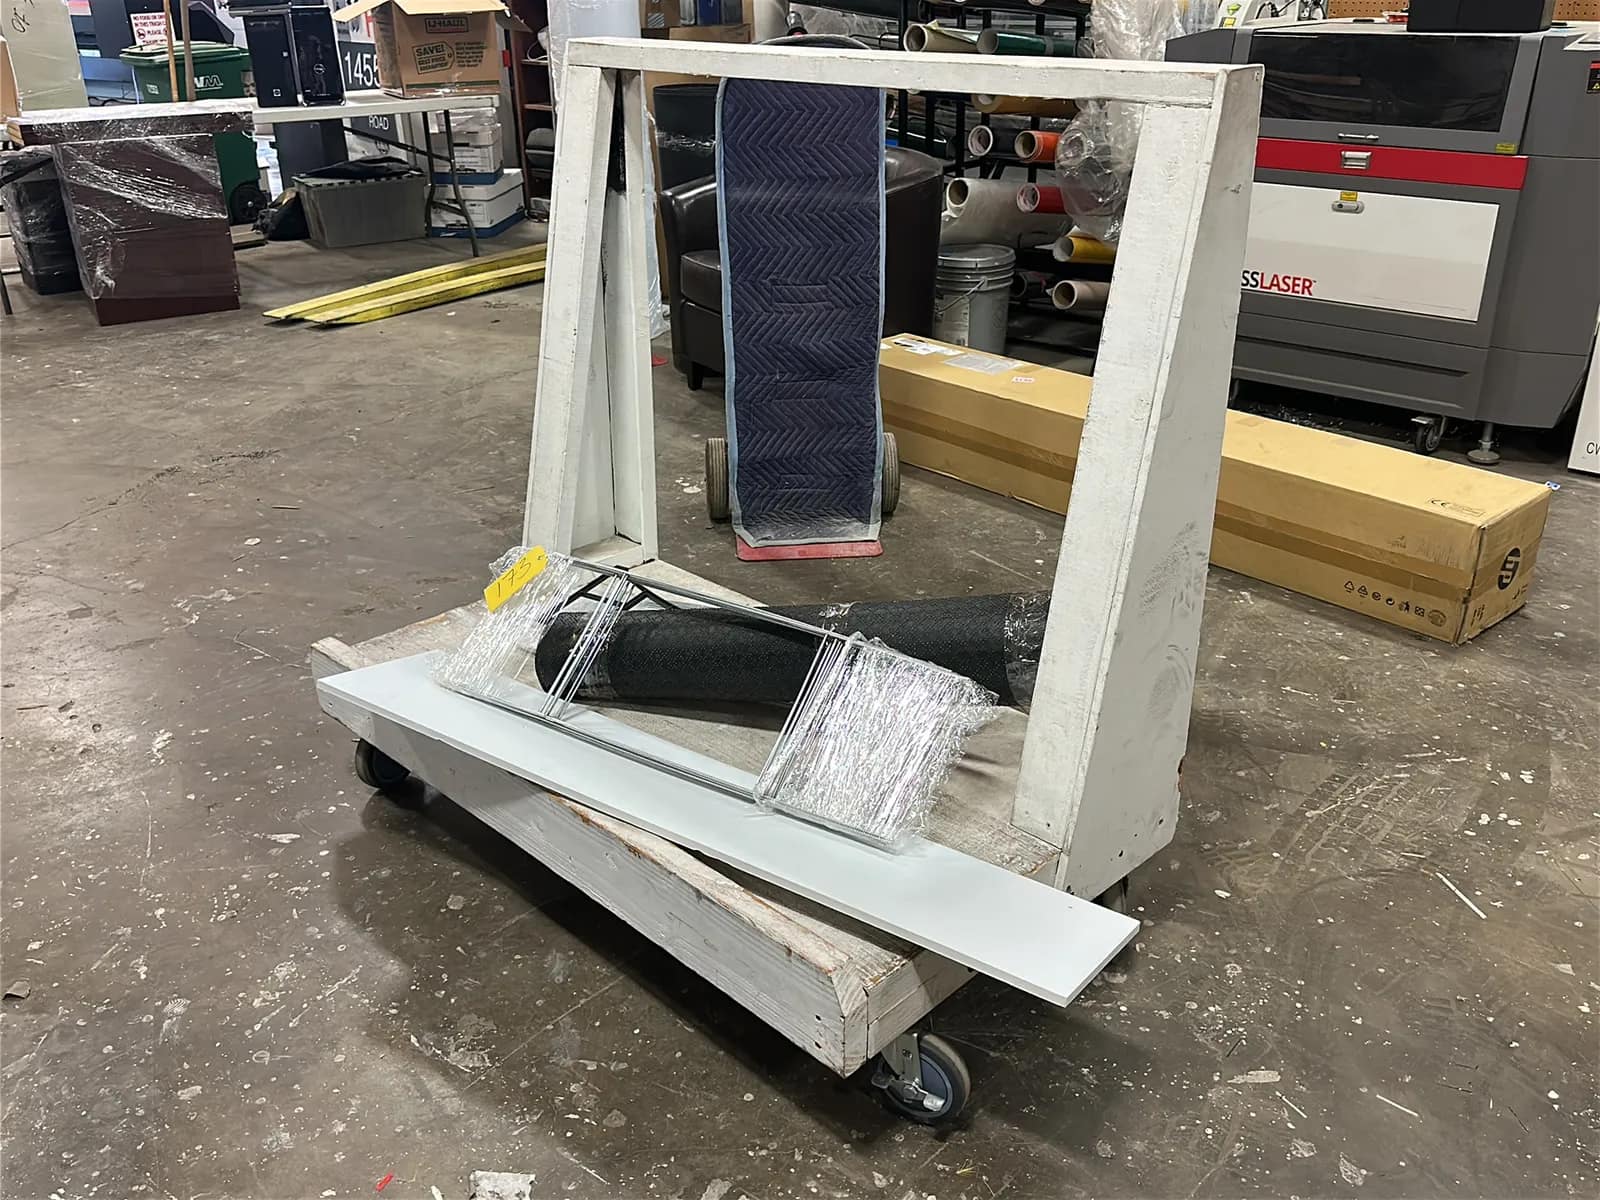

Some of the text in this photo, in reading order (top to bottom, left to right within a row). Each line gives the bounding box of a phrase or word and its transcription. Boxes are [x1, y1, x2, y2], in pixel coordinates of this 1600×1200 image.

[428, 20, 465, 28] U-HAUL
[415, 44, 445, 57] SAVE!
[368, 114, 389, 130] ROAD
